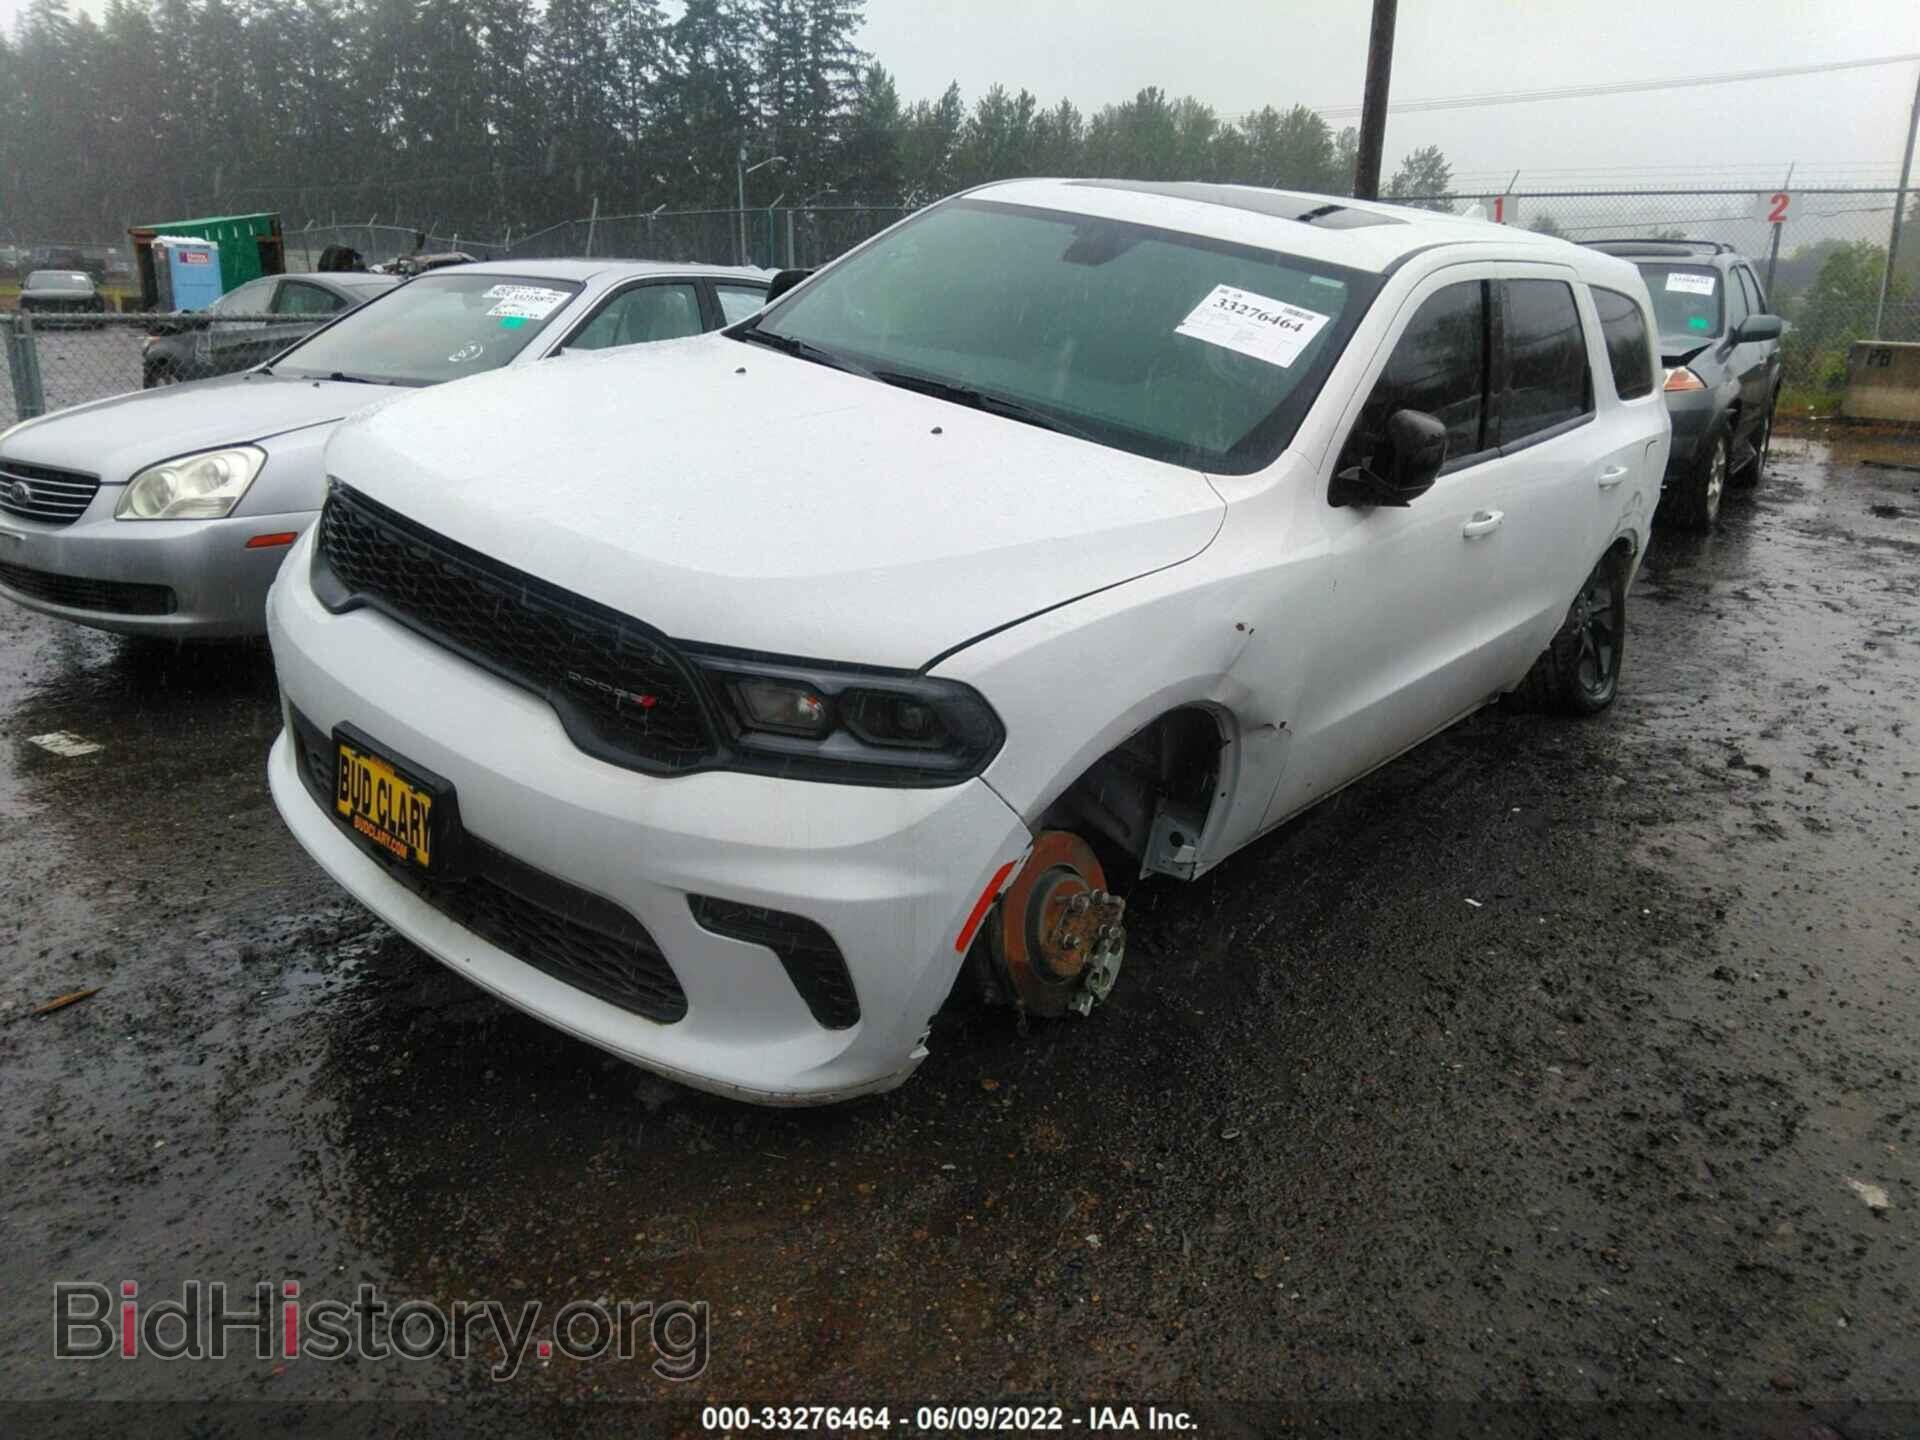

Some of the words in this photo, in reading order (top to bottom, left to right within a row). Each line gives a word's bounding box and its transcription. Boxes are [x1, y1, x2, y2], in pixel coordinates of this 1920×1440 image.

[1493, 196, 1504, 224] 1
[1767, 192, 1790, 223] 2
[1212, 297, 1304, 333] 33276464
[339, 754, 372, 816] BUD
[377, 777, 432, 853] CLARY
